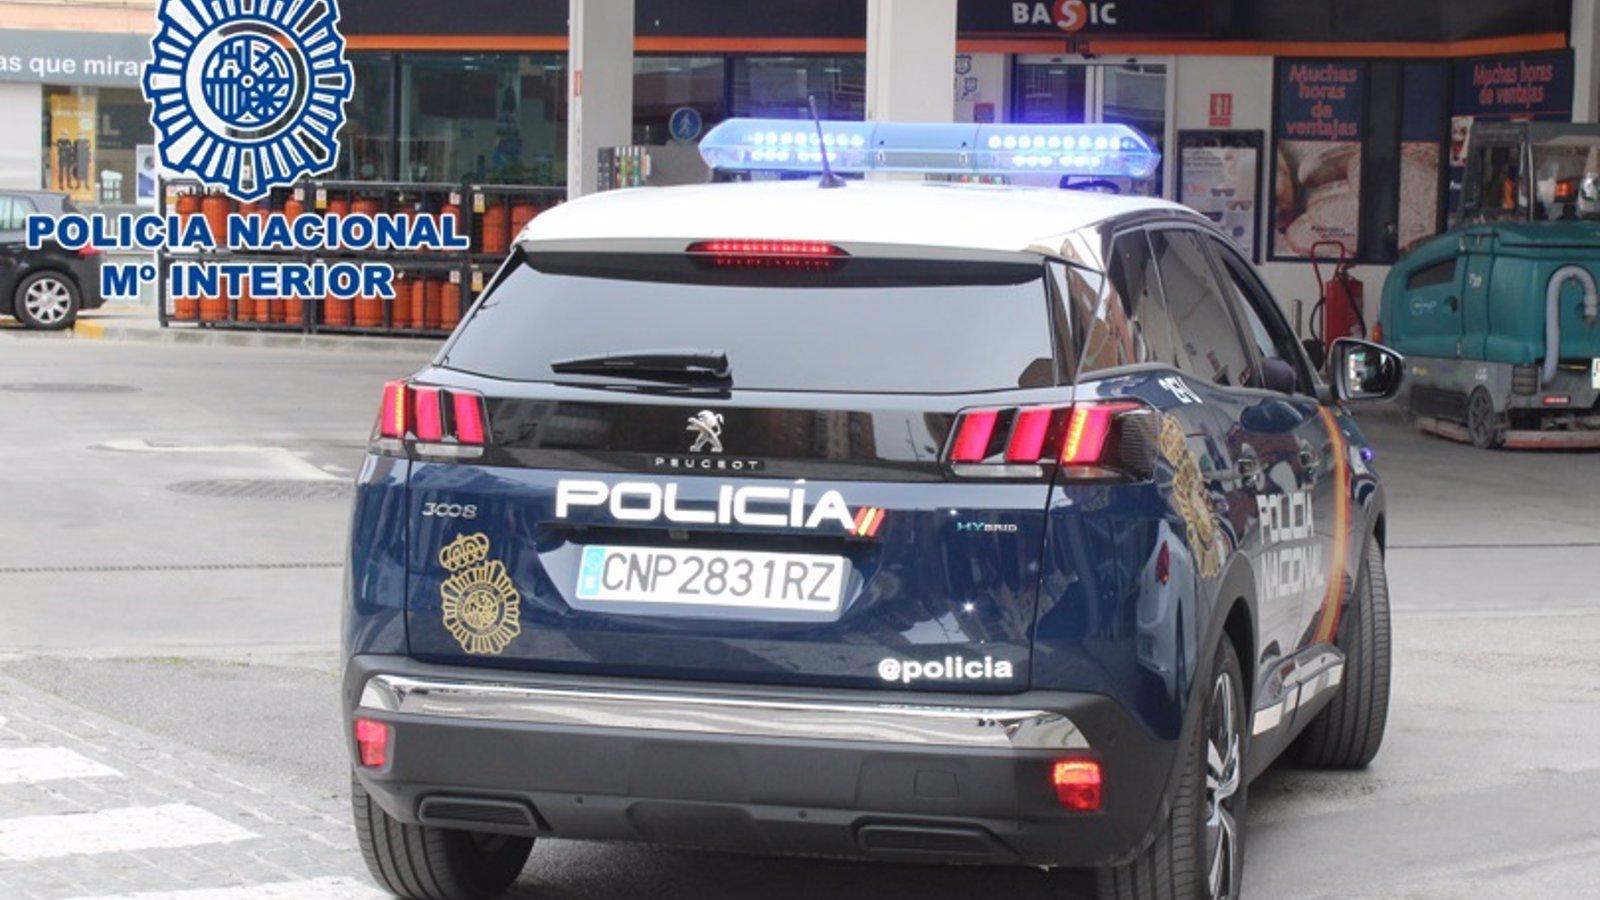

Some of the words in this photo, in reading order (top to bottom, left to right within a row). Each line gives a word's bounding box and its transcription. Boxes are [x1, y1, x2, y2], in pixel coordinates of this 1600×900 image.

[1011, 0, 1117, 28] BASIC
[29, 57, 76, 77] que
[1289, 64, 1357, 83] Muchas
[1521, 60, 1553, 82] horas
[1300, 83, 1345, 99] horas
[1480, 84, 1494, 105] de
[1497, 84, 1544, 109] ventajas
[1311, 101, 1332, 118] de
[1286, 119, 1357, 140] ventajas
[655, 456, 758, 470] PEUGEOT
[422, 502, 478, 519] 3008
[555, 478, 858, 530] POLICÍA
[601, 552, 836, 603] CNP2831RZ
[877, 655, 1014, 683] @policia
